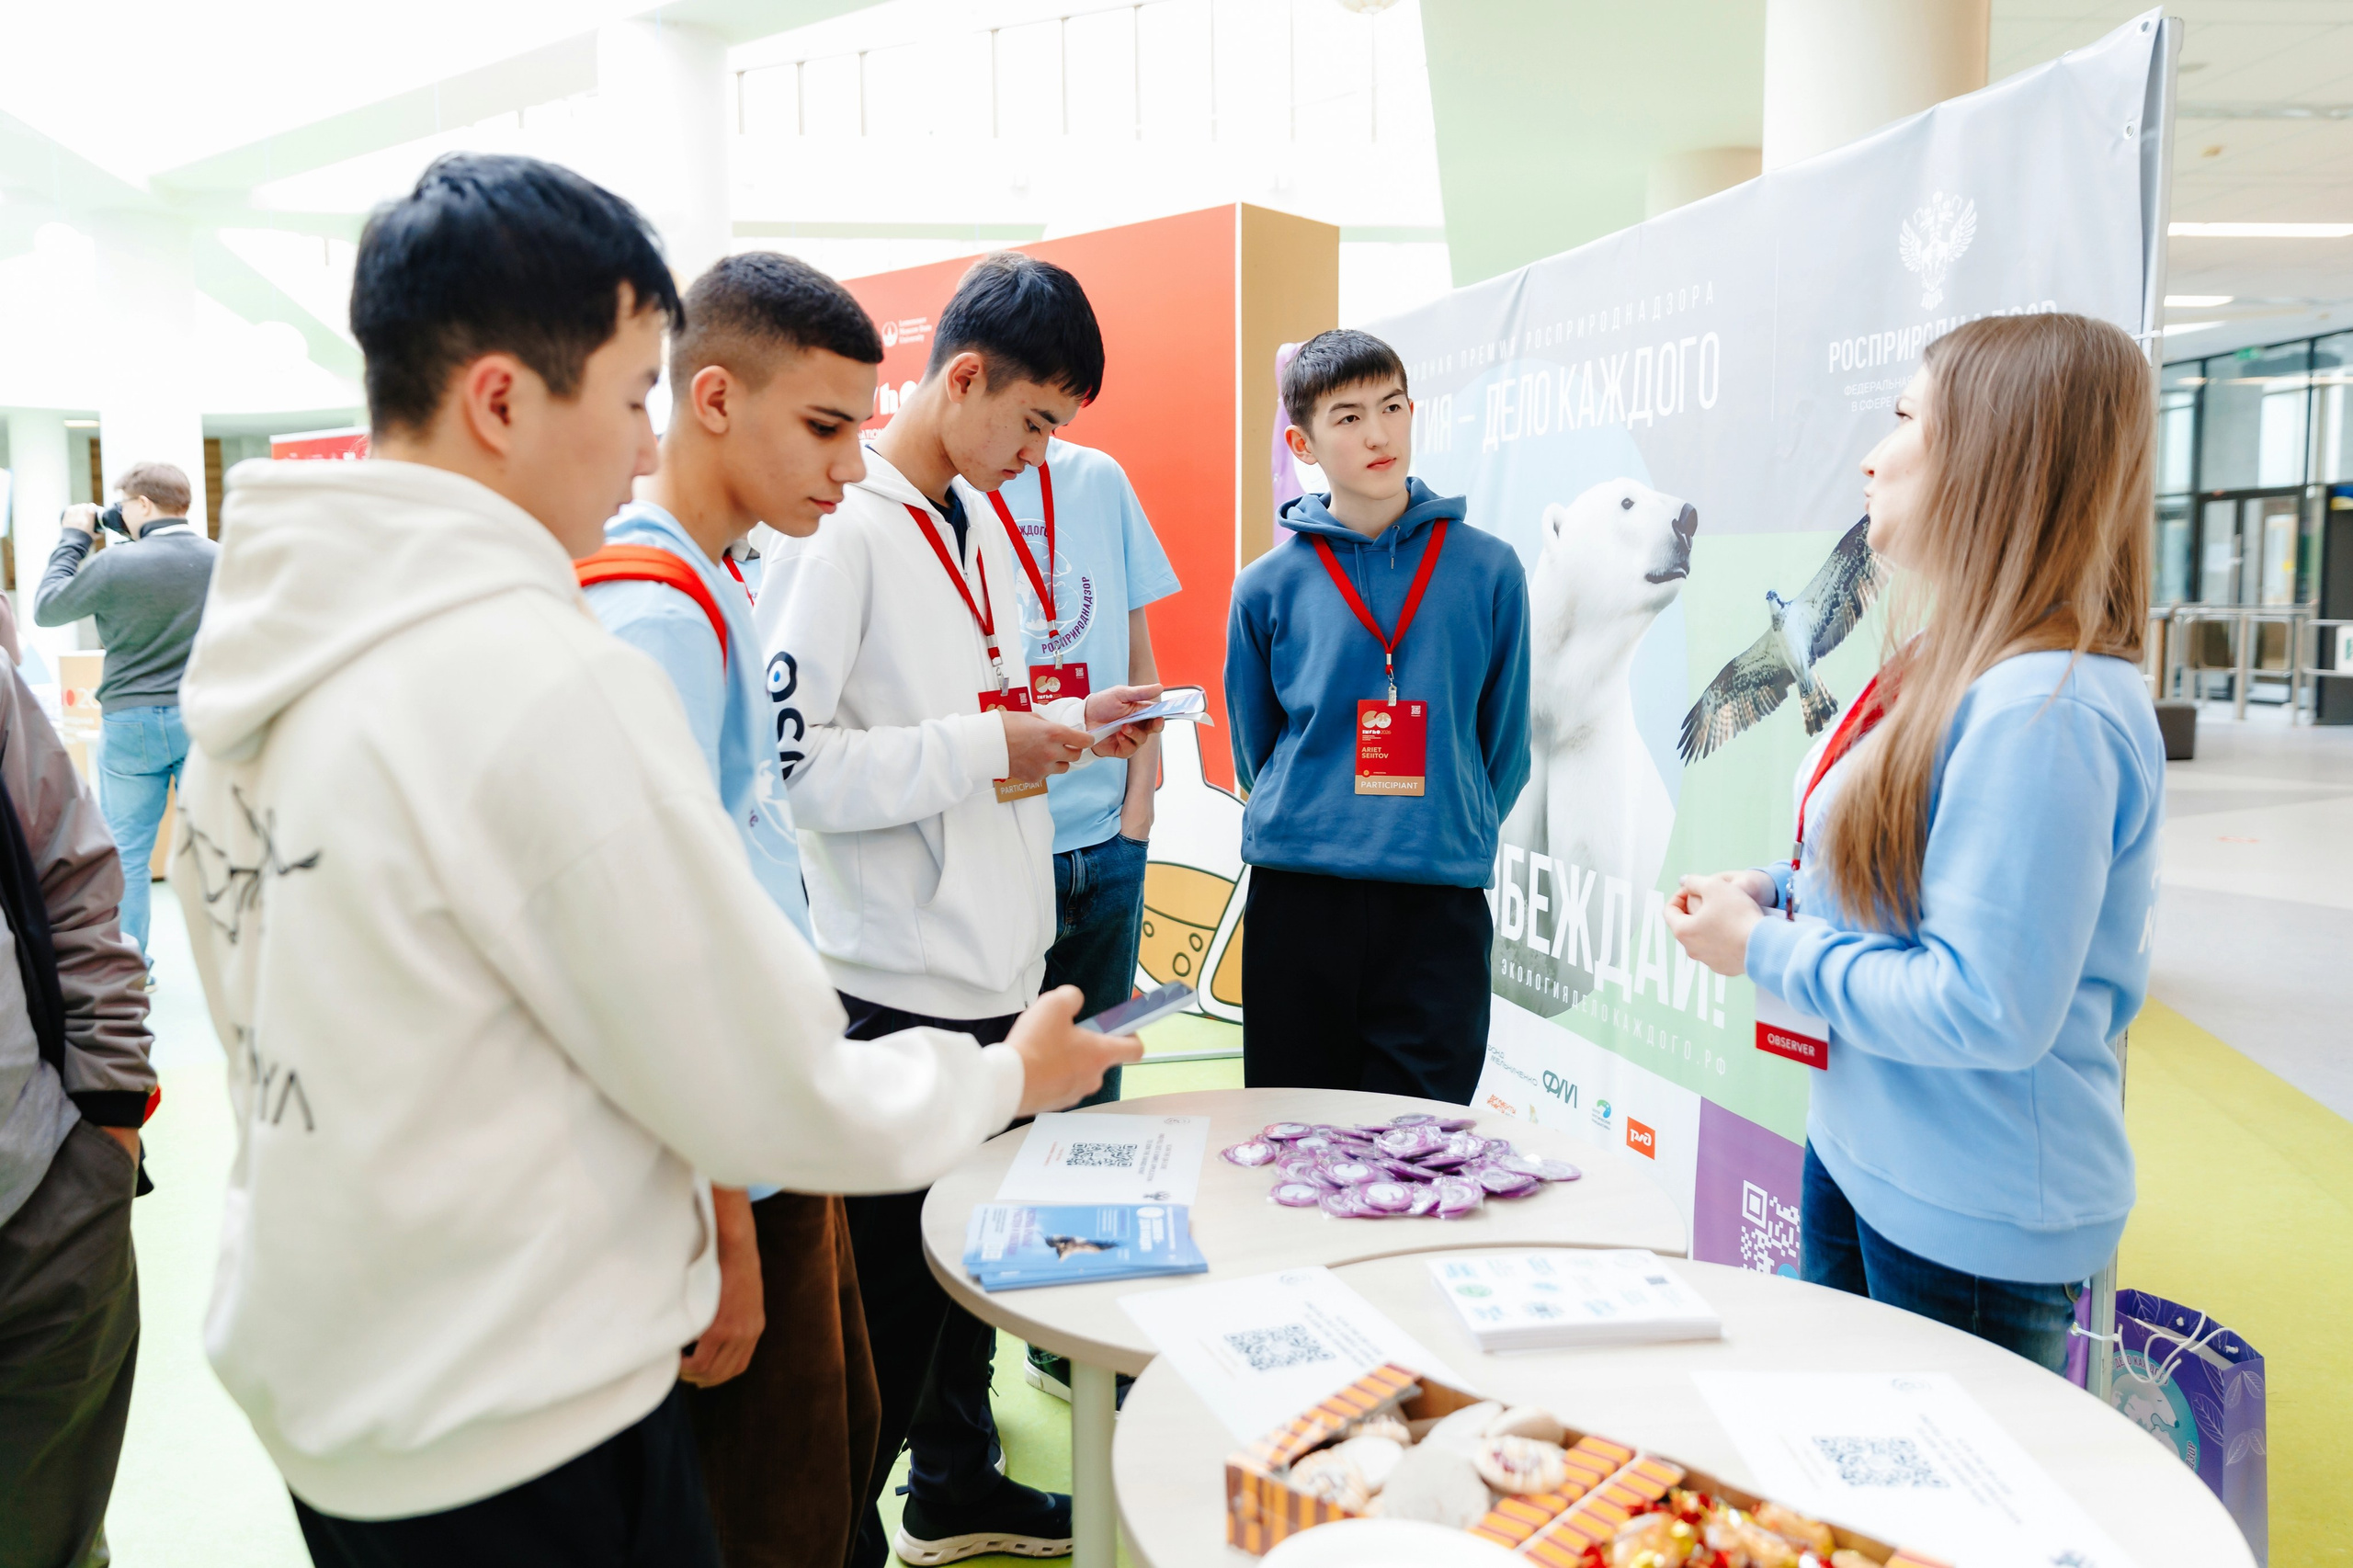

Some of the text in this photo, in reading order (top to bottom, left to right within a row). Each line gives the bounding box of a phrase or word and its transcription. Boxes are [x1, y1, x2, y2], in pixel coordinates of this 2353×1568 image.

[1526, 280, 1715, 352] РОСПРИРОДНАДЗОРА
[1413, 392, 1453, 456] ГИЯ
[1482, 369, 1552, 454] ДЕЛО
[1558, 331, 1721, 433] КАЖДОГО
[1360, 780, 1418, 790] PARTICIPIANT
[1767, 1032, 1816, 1057] OBSERVER
